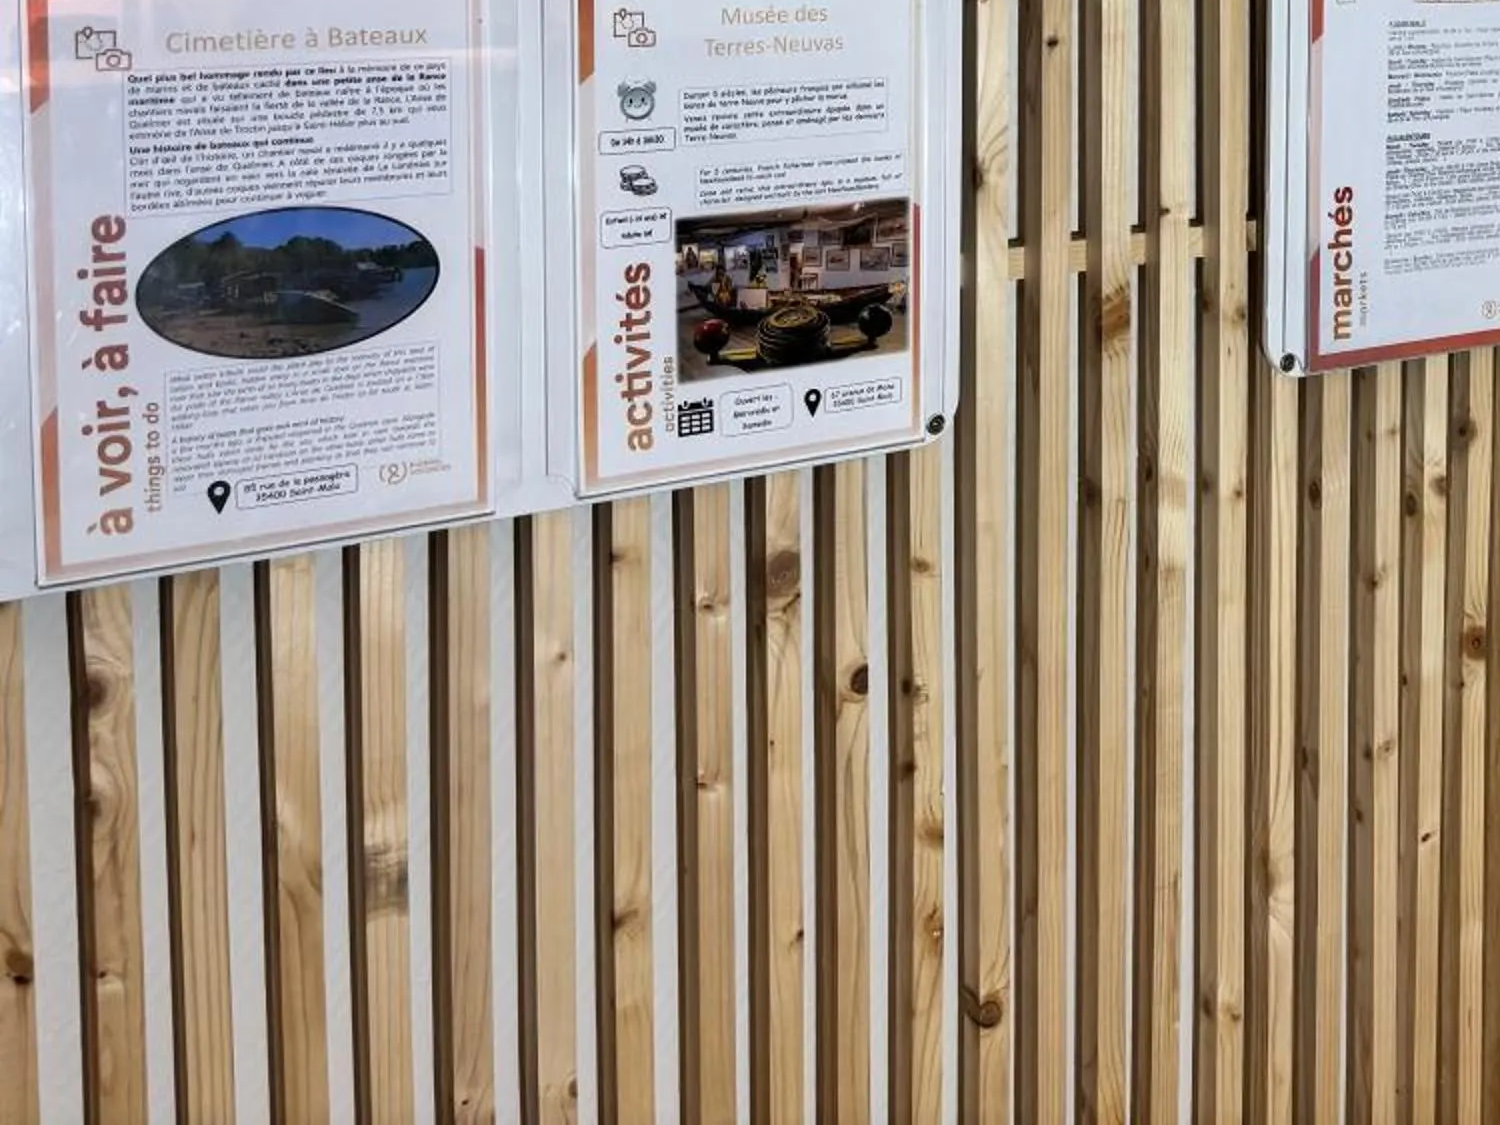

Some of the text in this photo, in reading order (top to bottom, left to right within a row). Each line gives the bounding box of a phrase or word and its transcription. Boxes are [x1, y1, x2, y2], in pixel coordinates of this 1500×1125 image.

[166, 27, 428, 54] Cimetière à Bateaux
[703, 34, 845, 57] Terres-Neuvas
[721, 3, 828, 26] Musée des
[129, 146, 151, 155] Une
[153, 143, 191, 153] histoire
[1327, 186, 1354, 342] marchés
[77, 215, 139, 536] à voir, à faire
[613, 261, 654, 452] activités
[663, 356, 676, 433] activities
[142, 402, 165, 513] things to do
